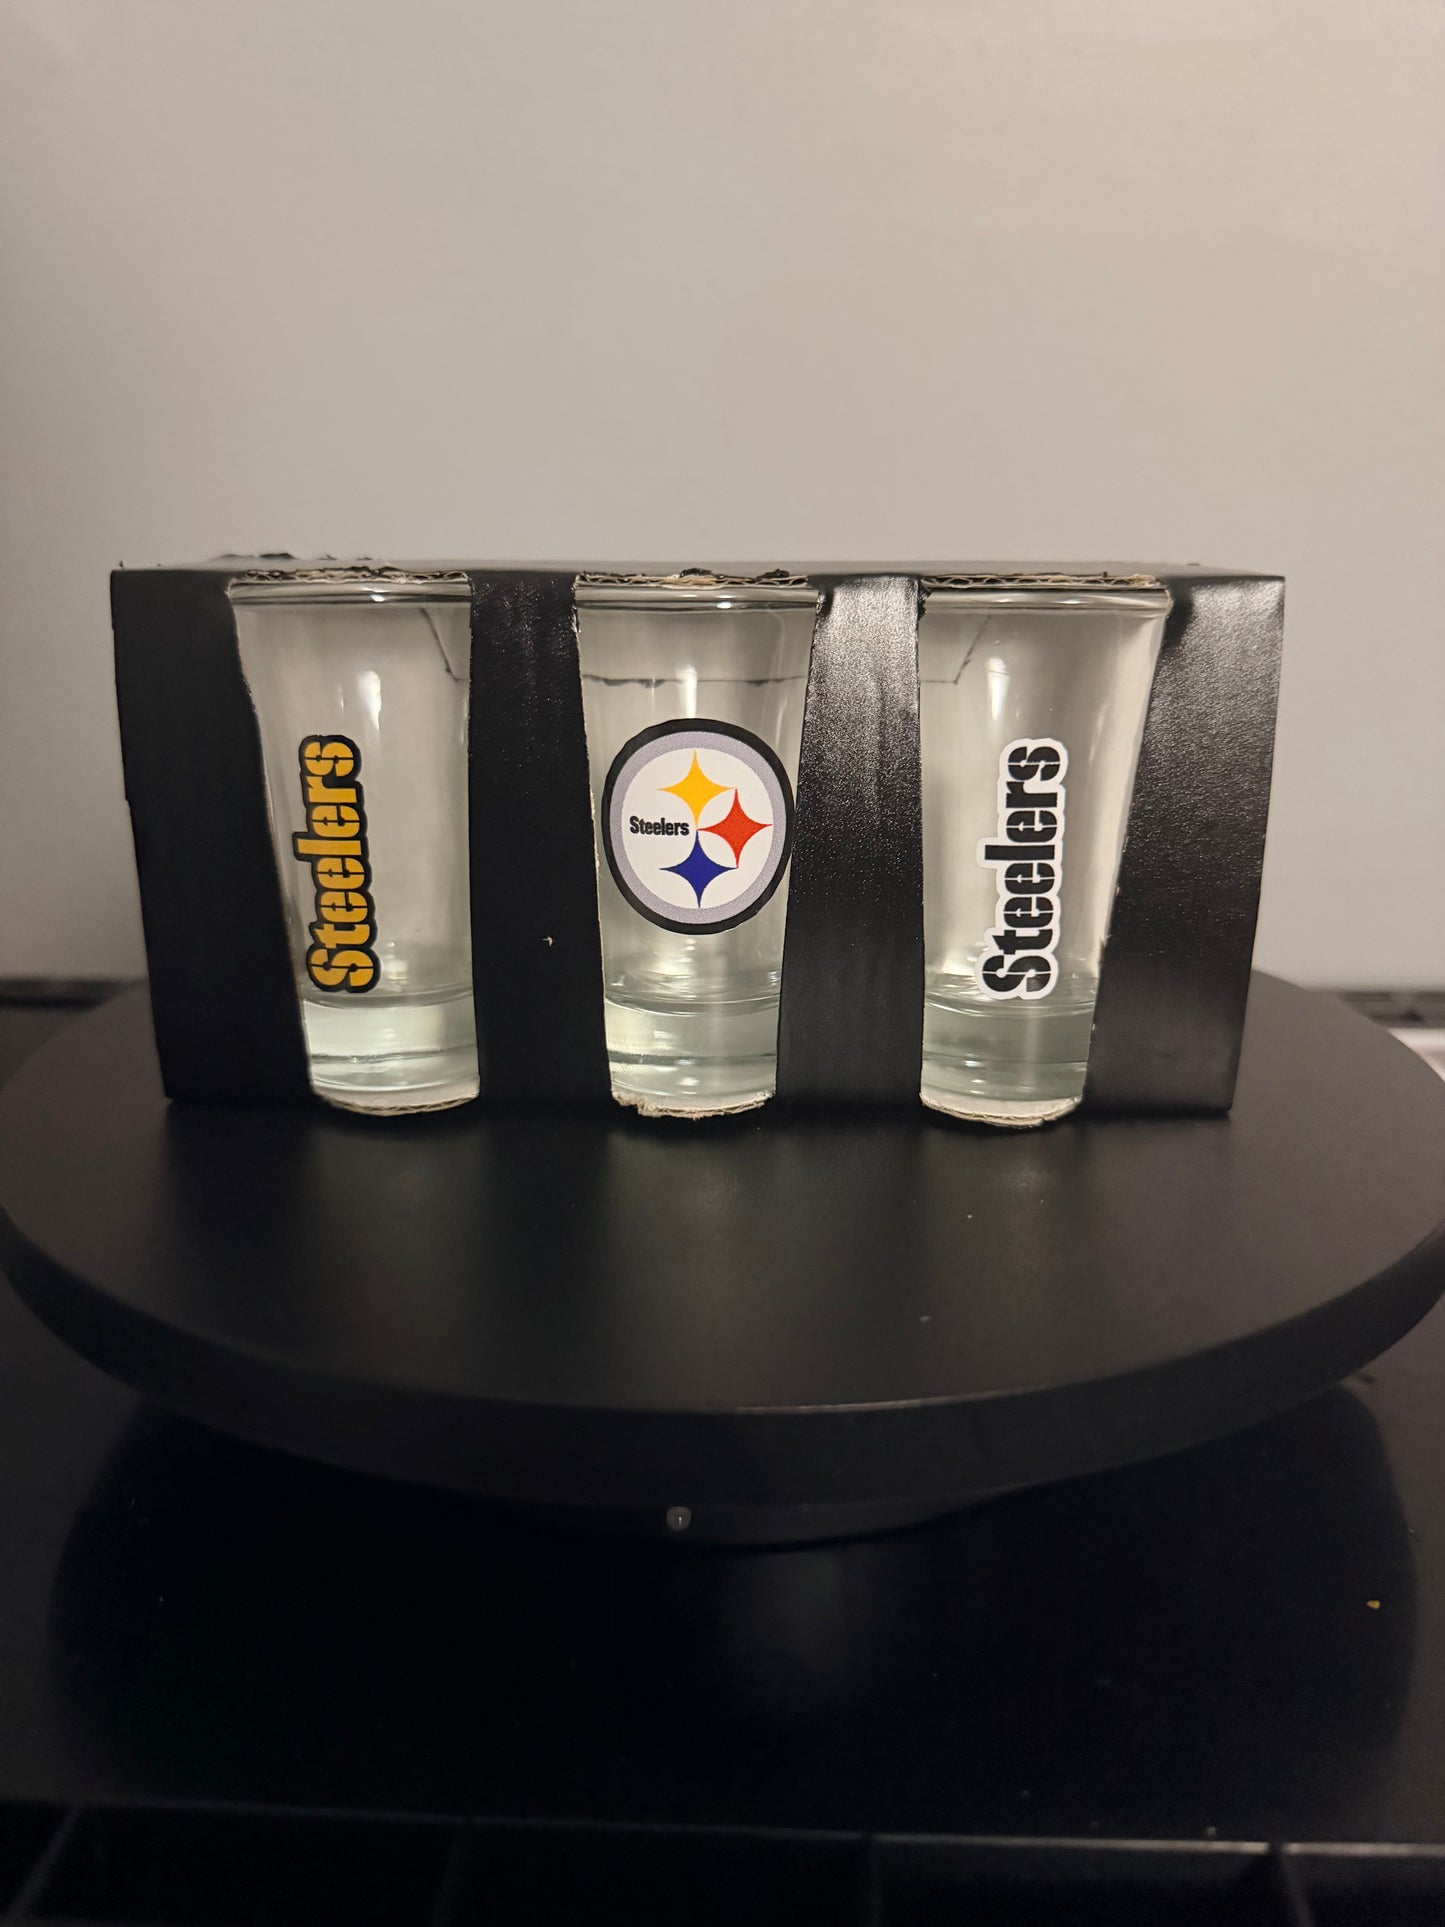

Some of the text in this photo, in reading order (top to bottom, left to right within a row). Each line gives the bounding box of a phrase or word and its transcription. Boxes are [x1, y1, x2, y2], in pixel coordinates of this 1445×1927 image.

[295, 739, 376, 989] Steelers
[629, 815, 690, 836] Steelers
[981, 745, 1061, 993] Steelers
